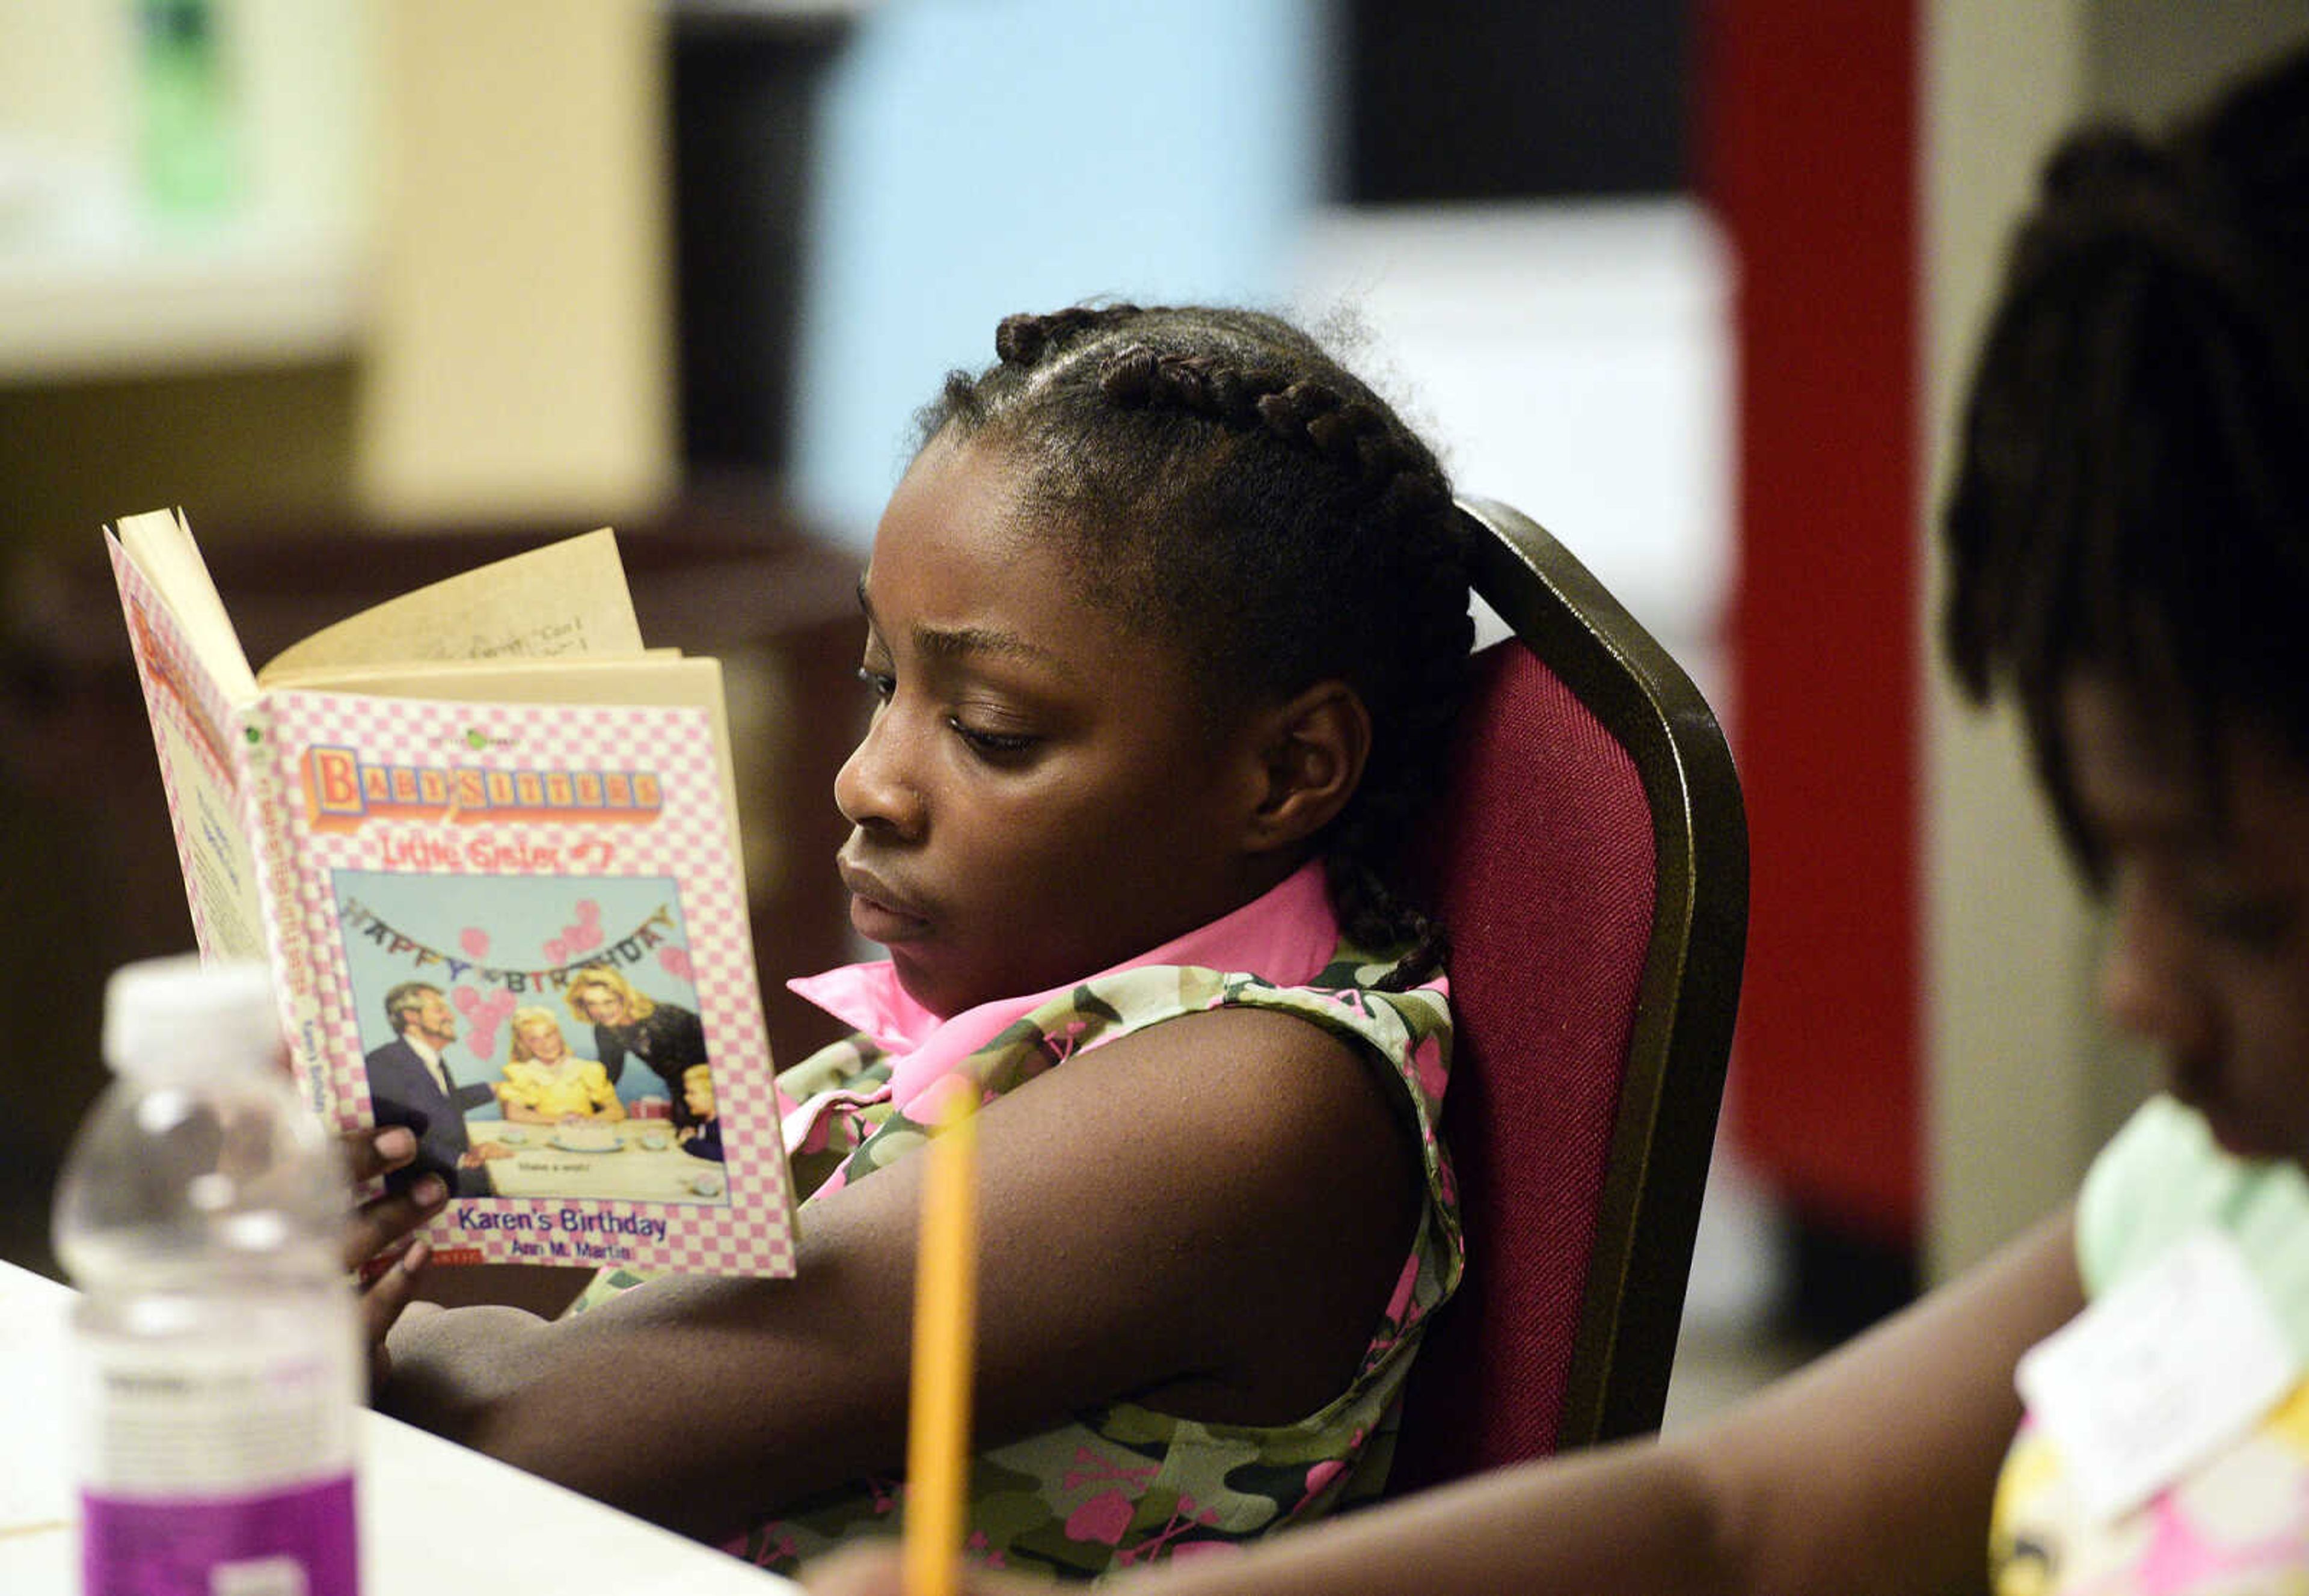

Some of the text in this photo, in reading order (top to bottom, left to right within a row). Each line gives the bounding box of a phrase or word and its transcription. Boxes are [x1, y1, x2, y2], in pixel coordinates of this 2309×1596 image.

[458, 1207, 666, 1242] Karen's Birthday
[512, 1238, 631, 1260] Ann M. Martin
